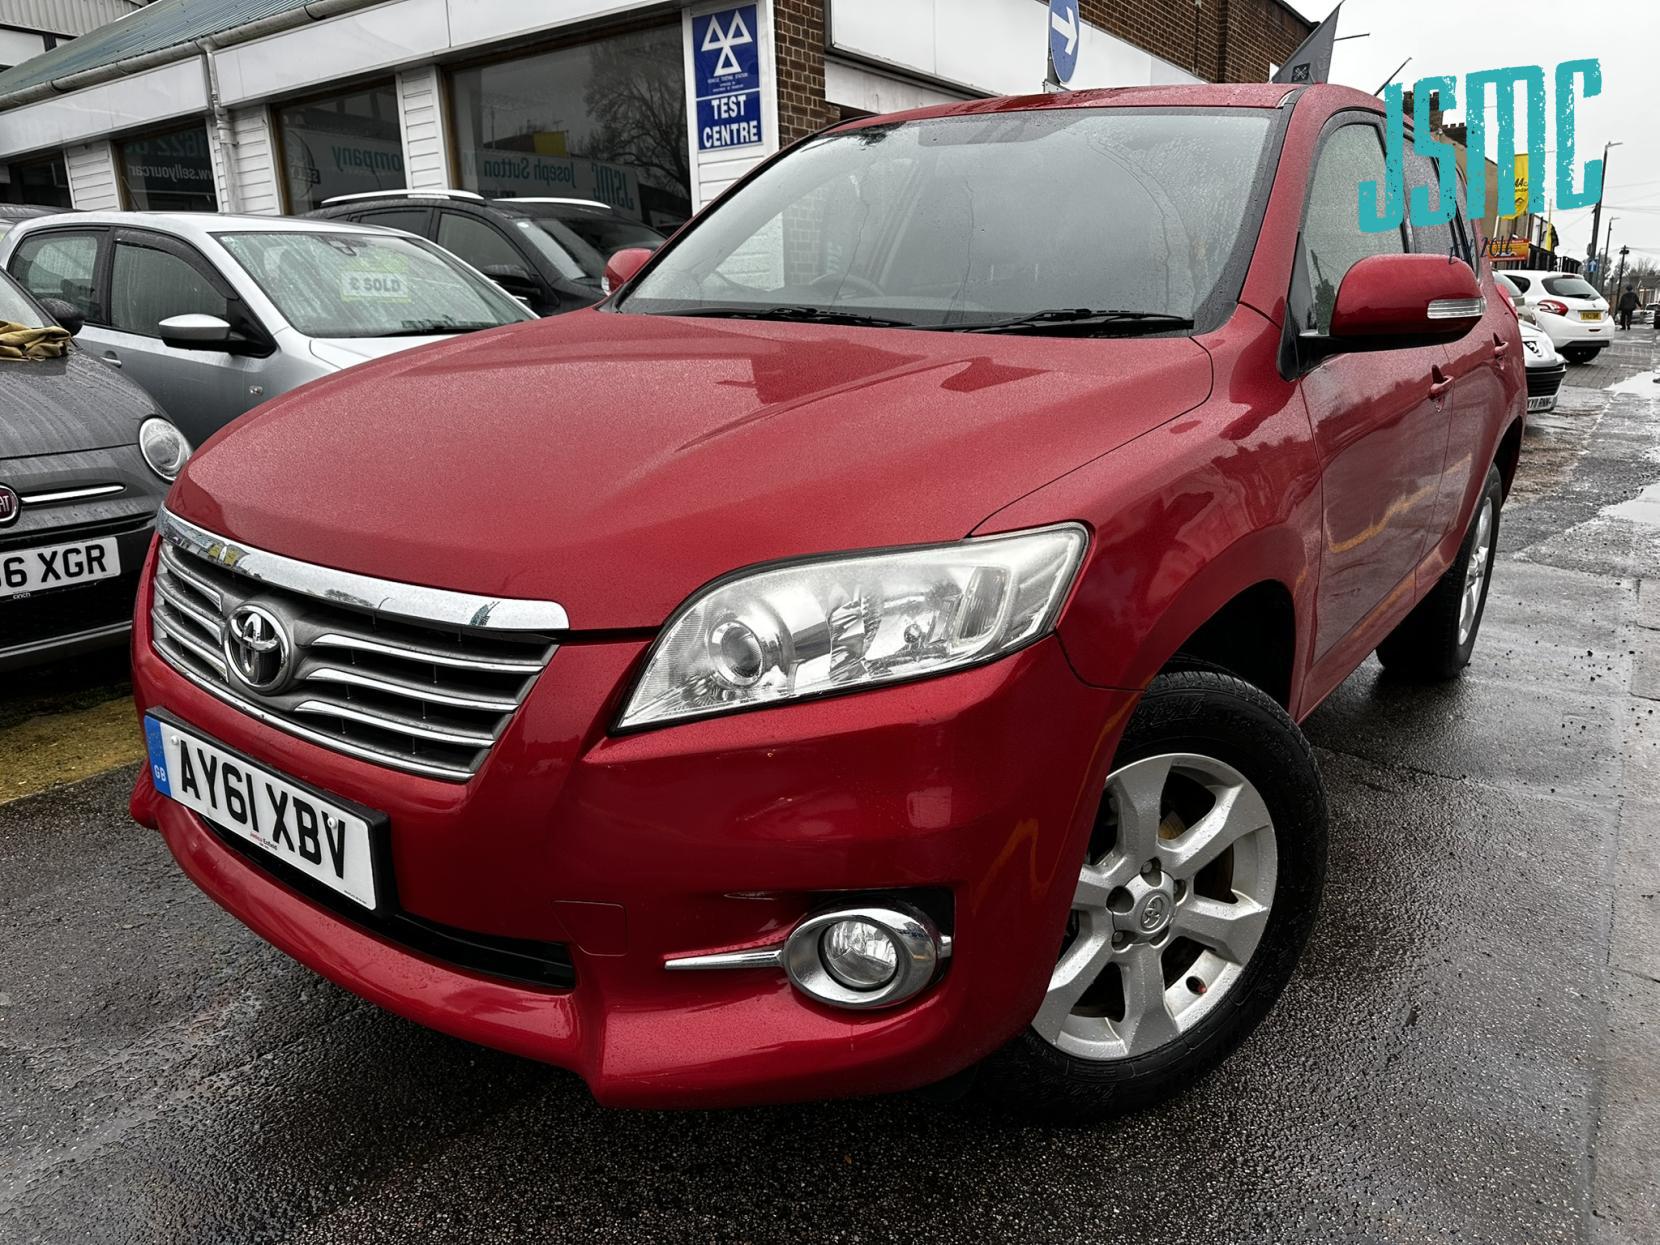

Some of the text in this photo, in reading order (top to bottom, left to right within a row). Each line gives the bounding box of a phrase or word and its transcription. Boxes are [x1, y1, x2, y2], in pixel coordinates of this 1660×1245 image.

[711, 95, 747, 120] TEST
[703, 120, 759, 148] CENTRE
[363, 277, 401, 293] SOLD
[37, 544, 107, 583] XGR
[153, 764, 167, 782] GB
[180, 740, 346, 880] AY61 XBV
